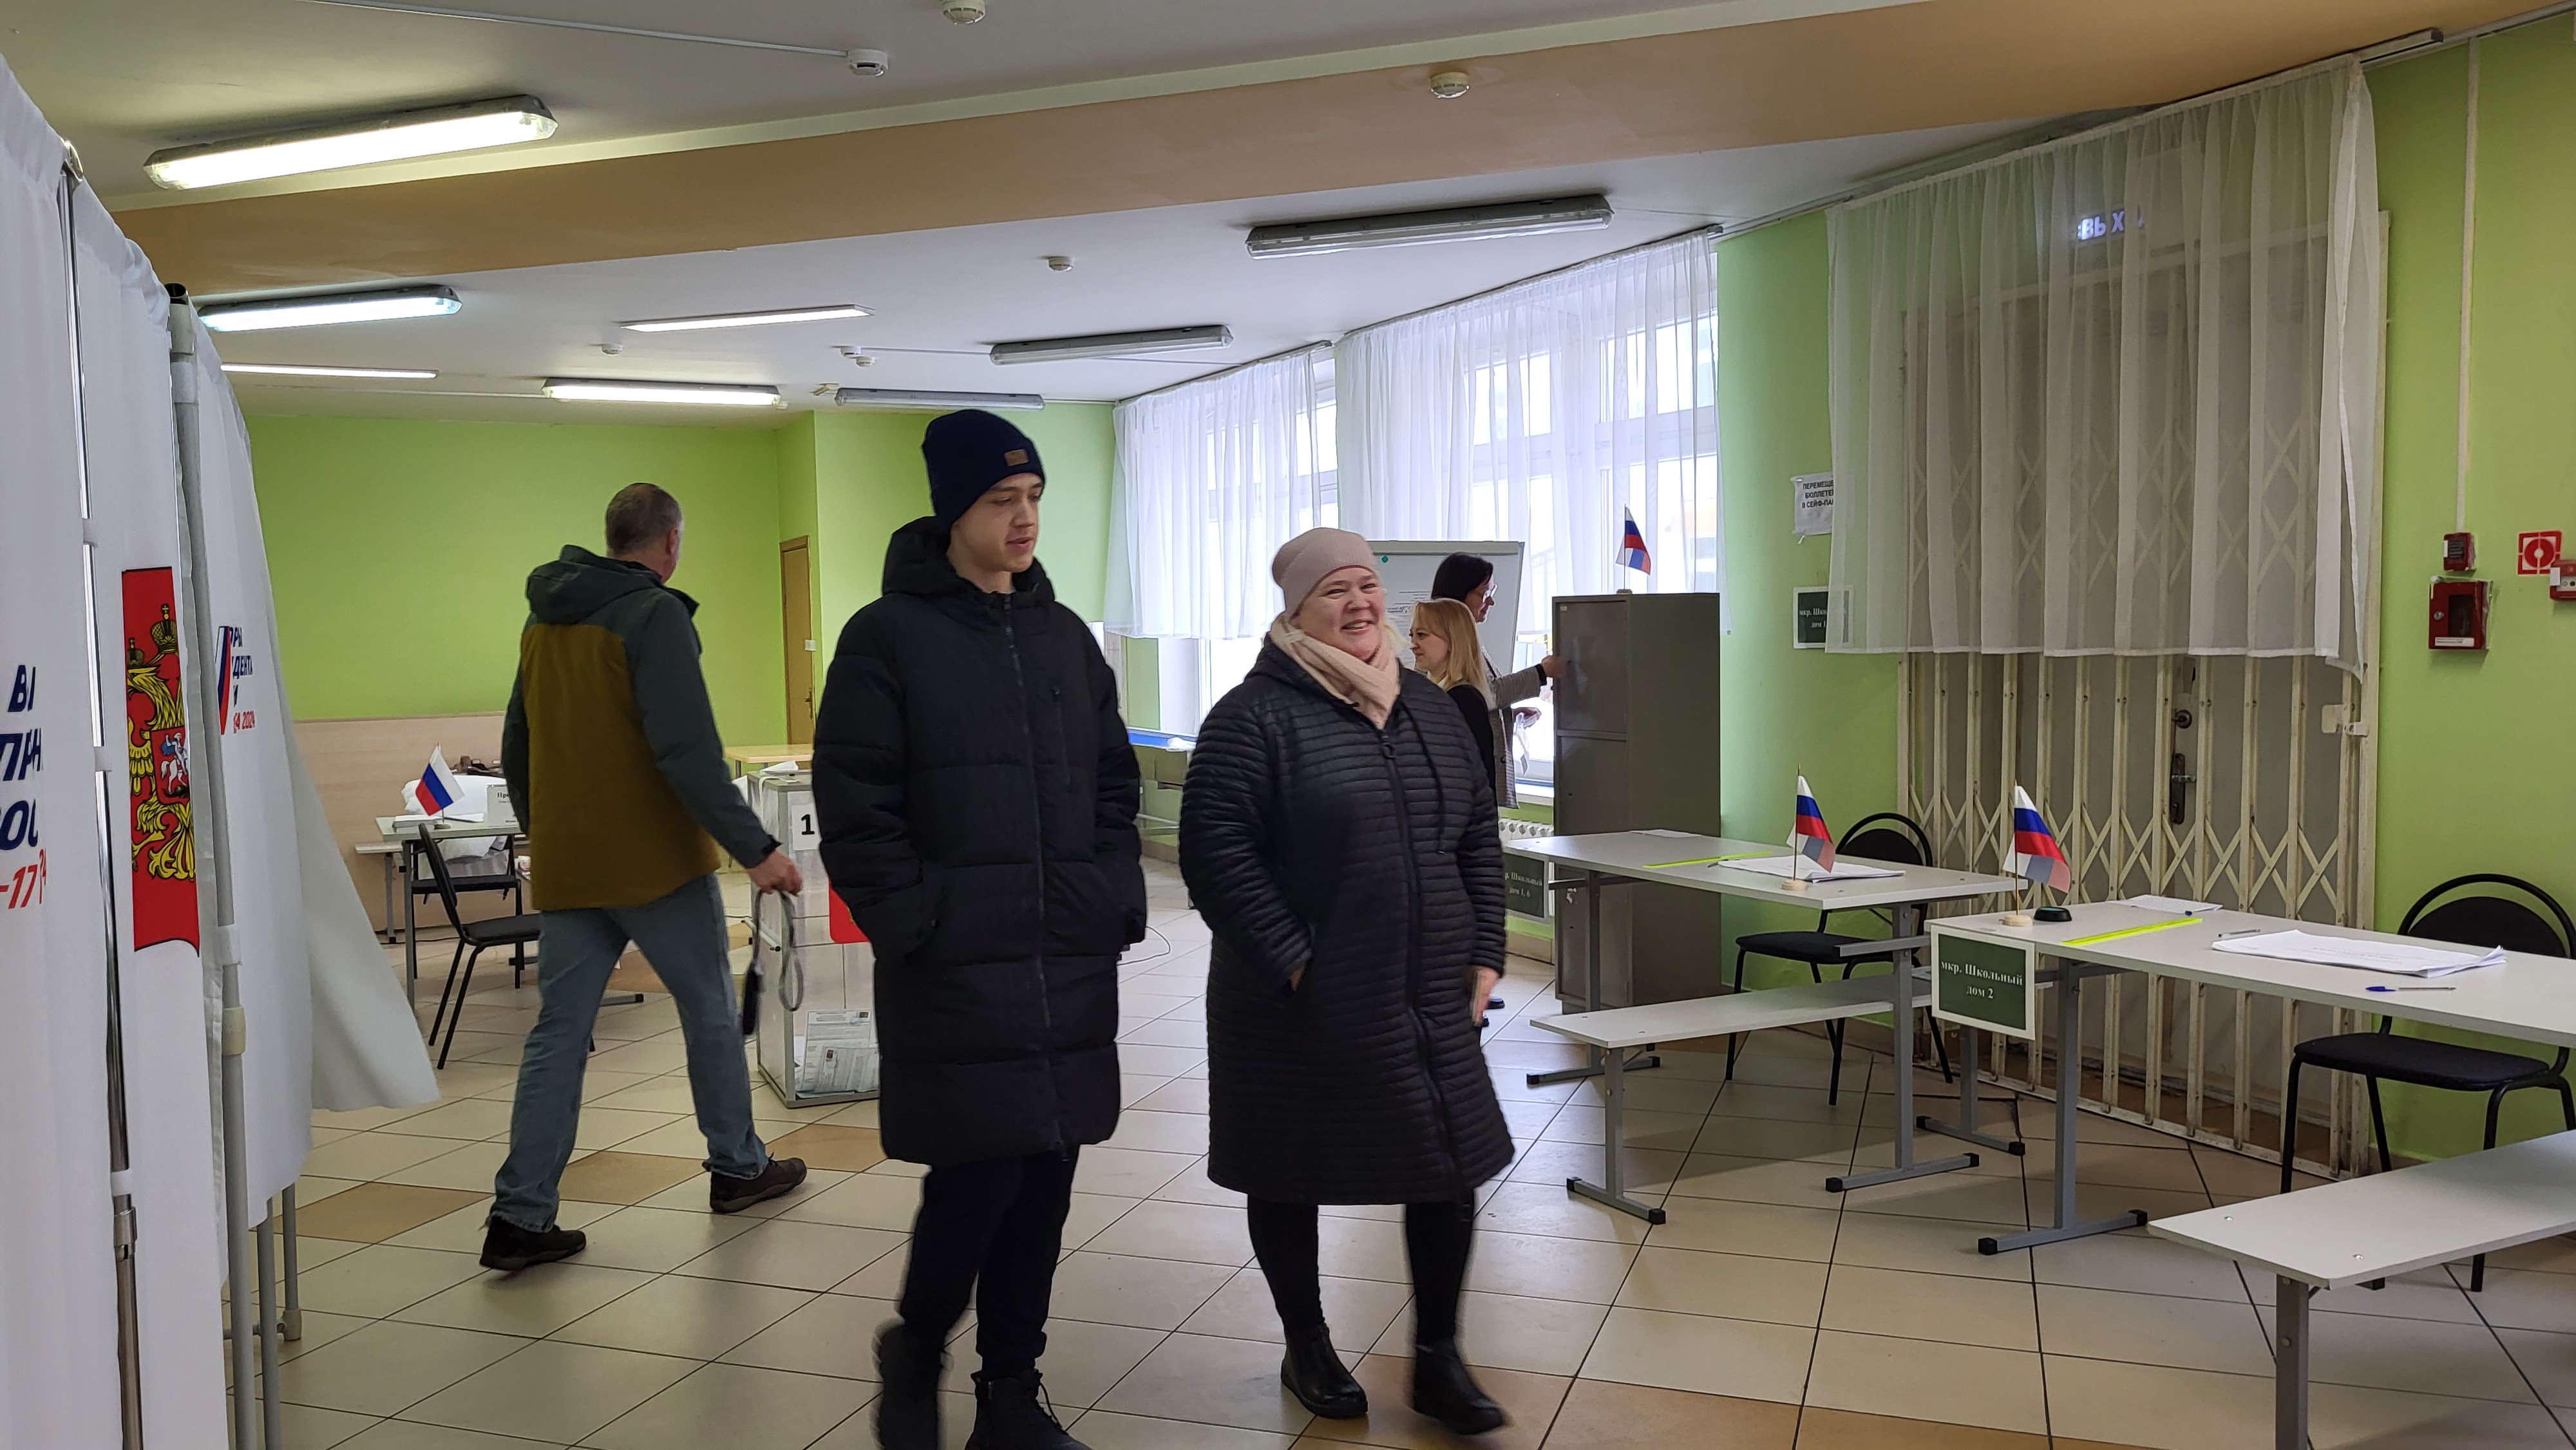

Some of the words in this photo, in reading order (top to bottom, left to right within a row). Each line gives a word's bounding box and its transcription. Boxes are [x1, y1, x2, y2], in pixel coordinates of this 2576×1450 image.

[800, 814, 815, 836] 1
[1941, 961, 1962, 975] мкр.
[1965, 963, 2022, 986] Школьный
[1966, 986, 1985, 997] дом
[1987, 988, 1994, 999] 2
